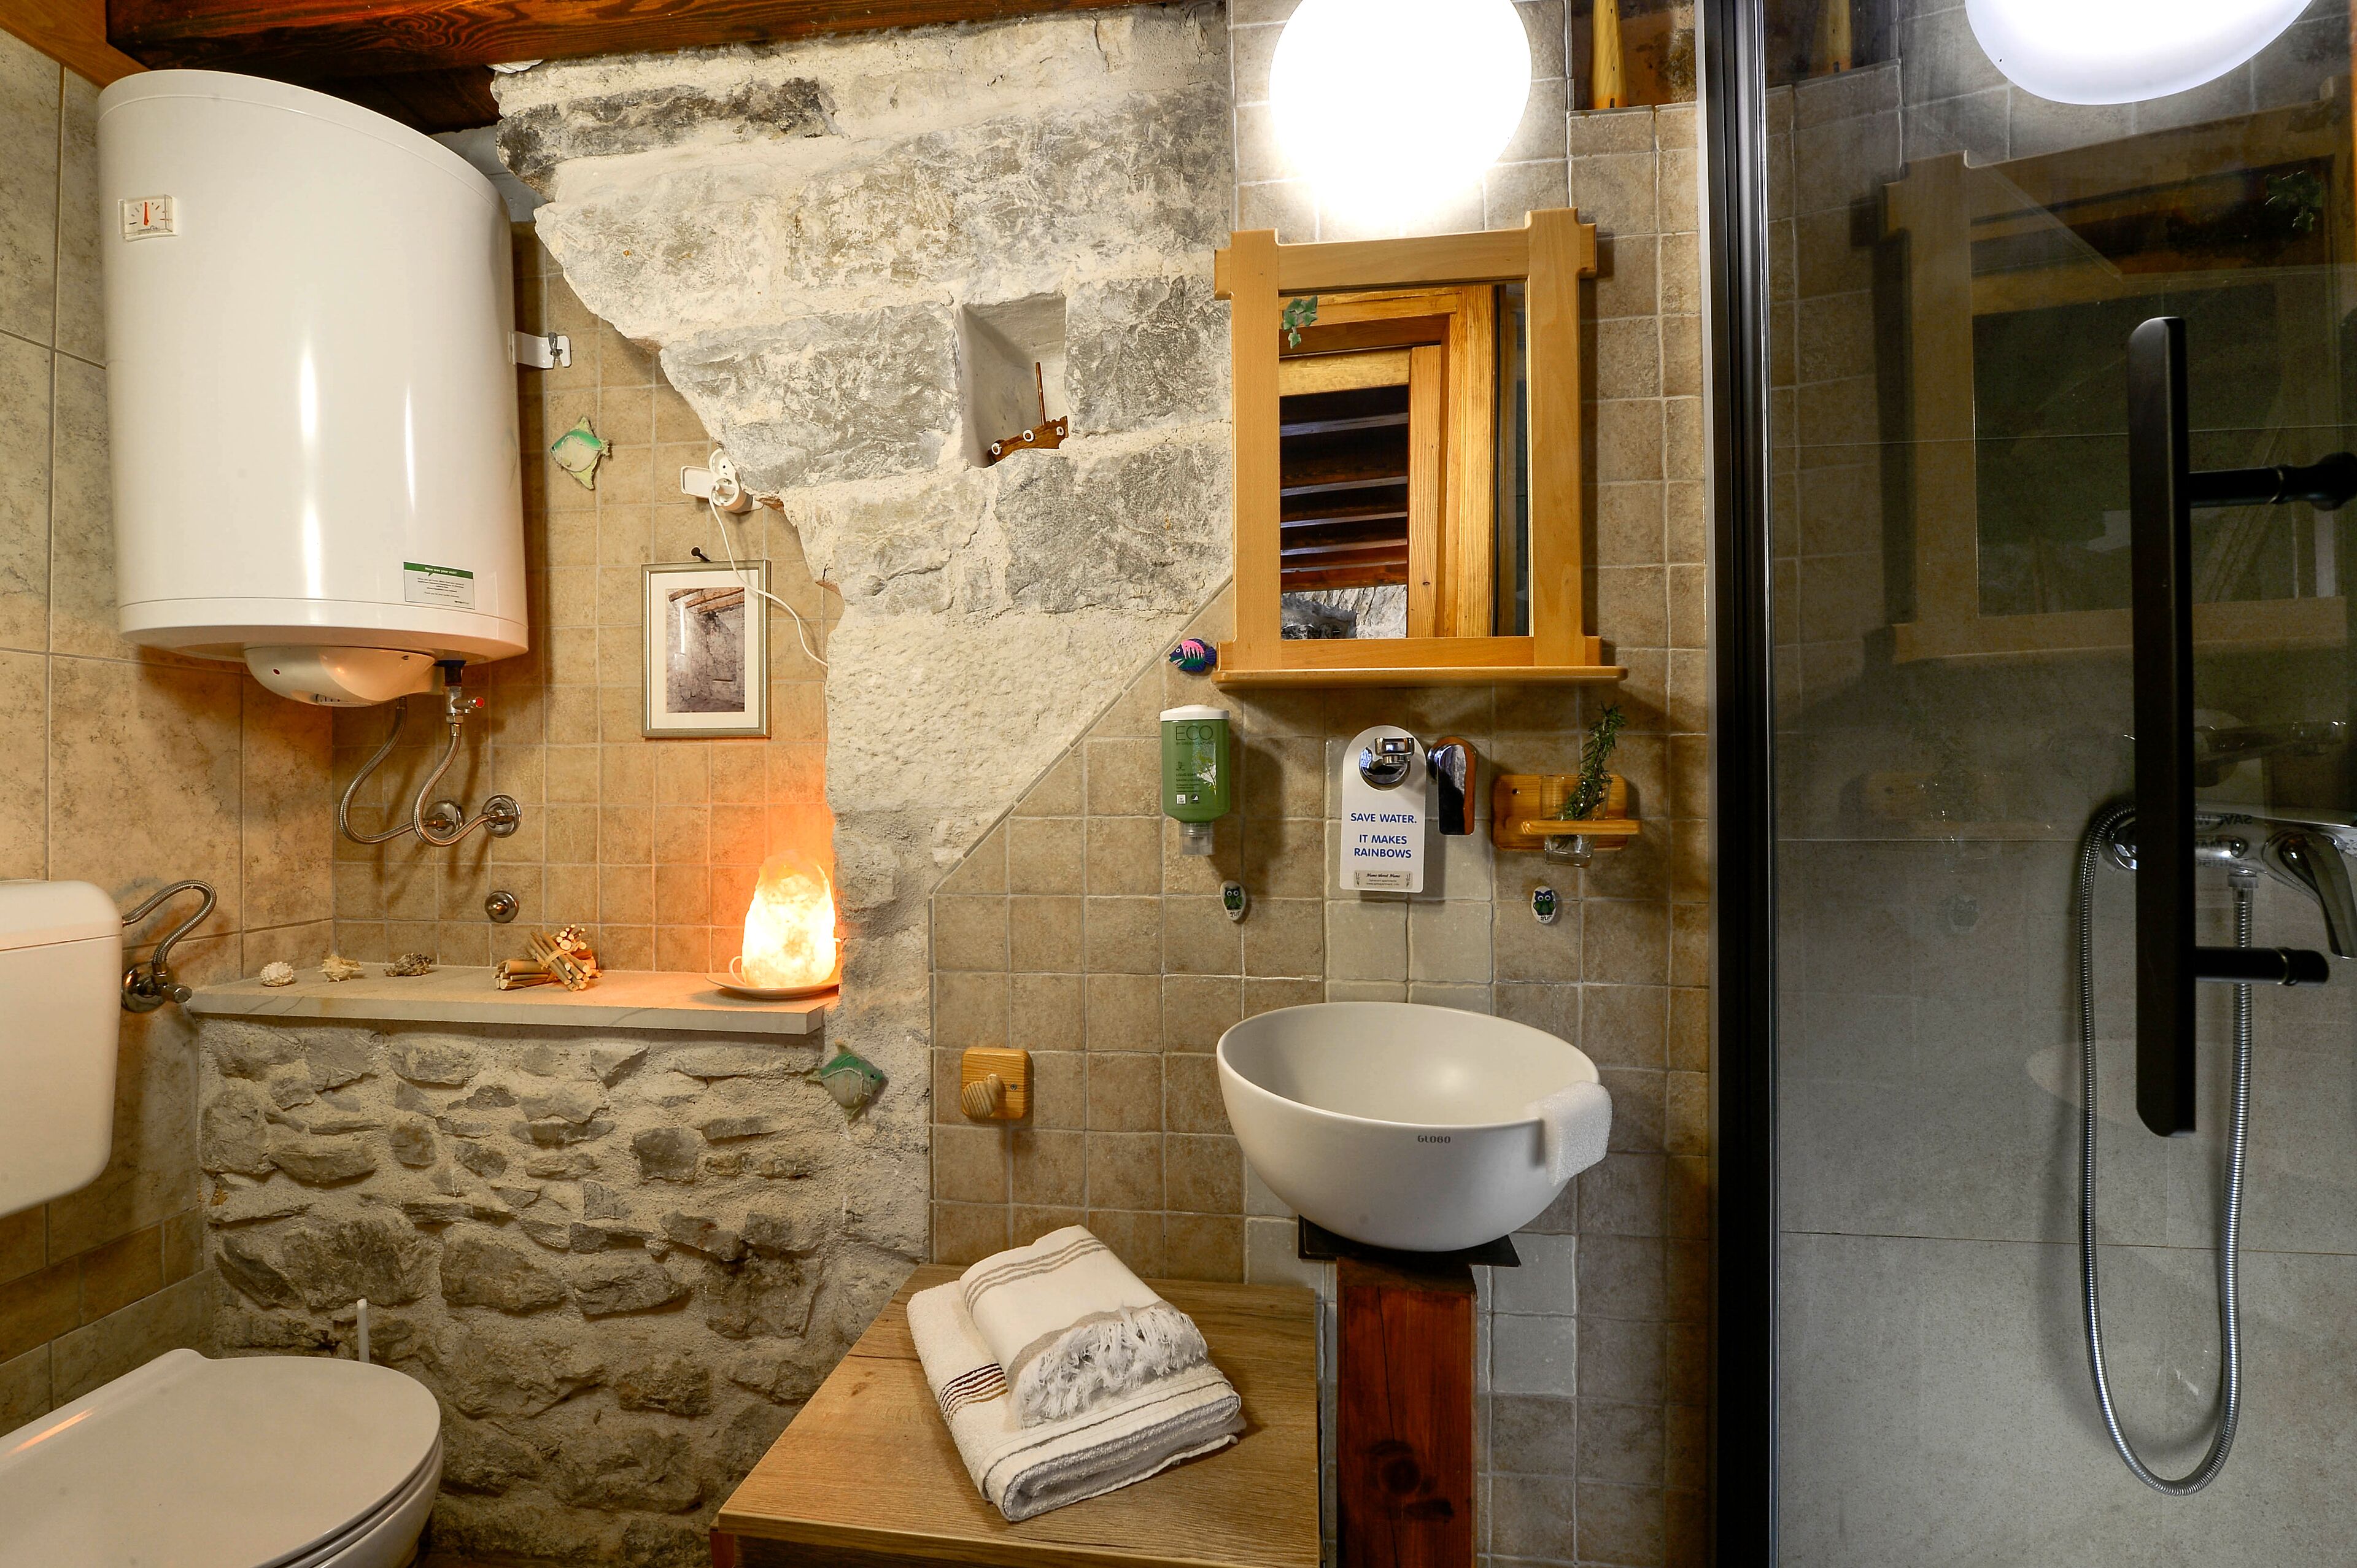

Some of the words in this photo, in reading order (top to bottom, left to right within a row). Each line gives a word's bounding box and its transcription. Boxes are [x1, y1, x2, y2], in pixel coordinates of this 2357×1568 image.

[1175, 725, 1213, 740] ECO
[1350, 813, 1376, 822] SAVE
[1379, 814, 1417, 824] WATER.
[1359, 834, 1368, 843] IT
[1371, 835, 1407, 844] MAKES
[1354, 848, 1411, 858] RAINBOWS
